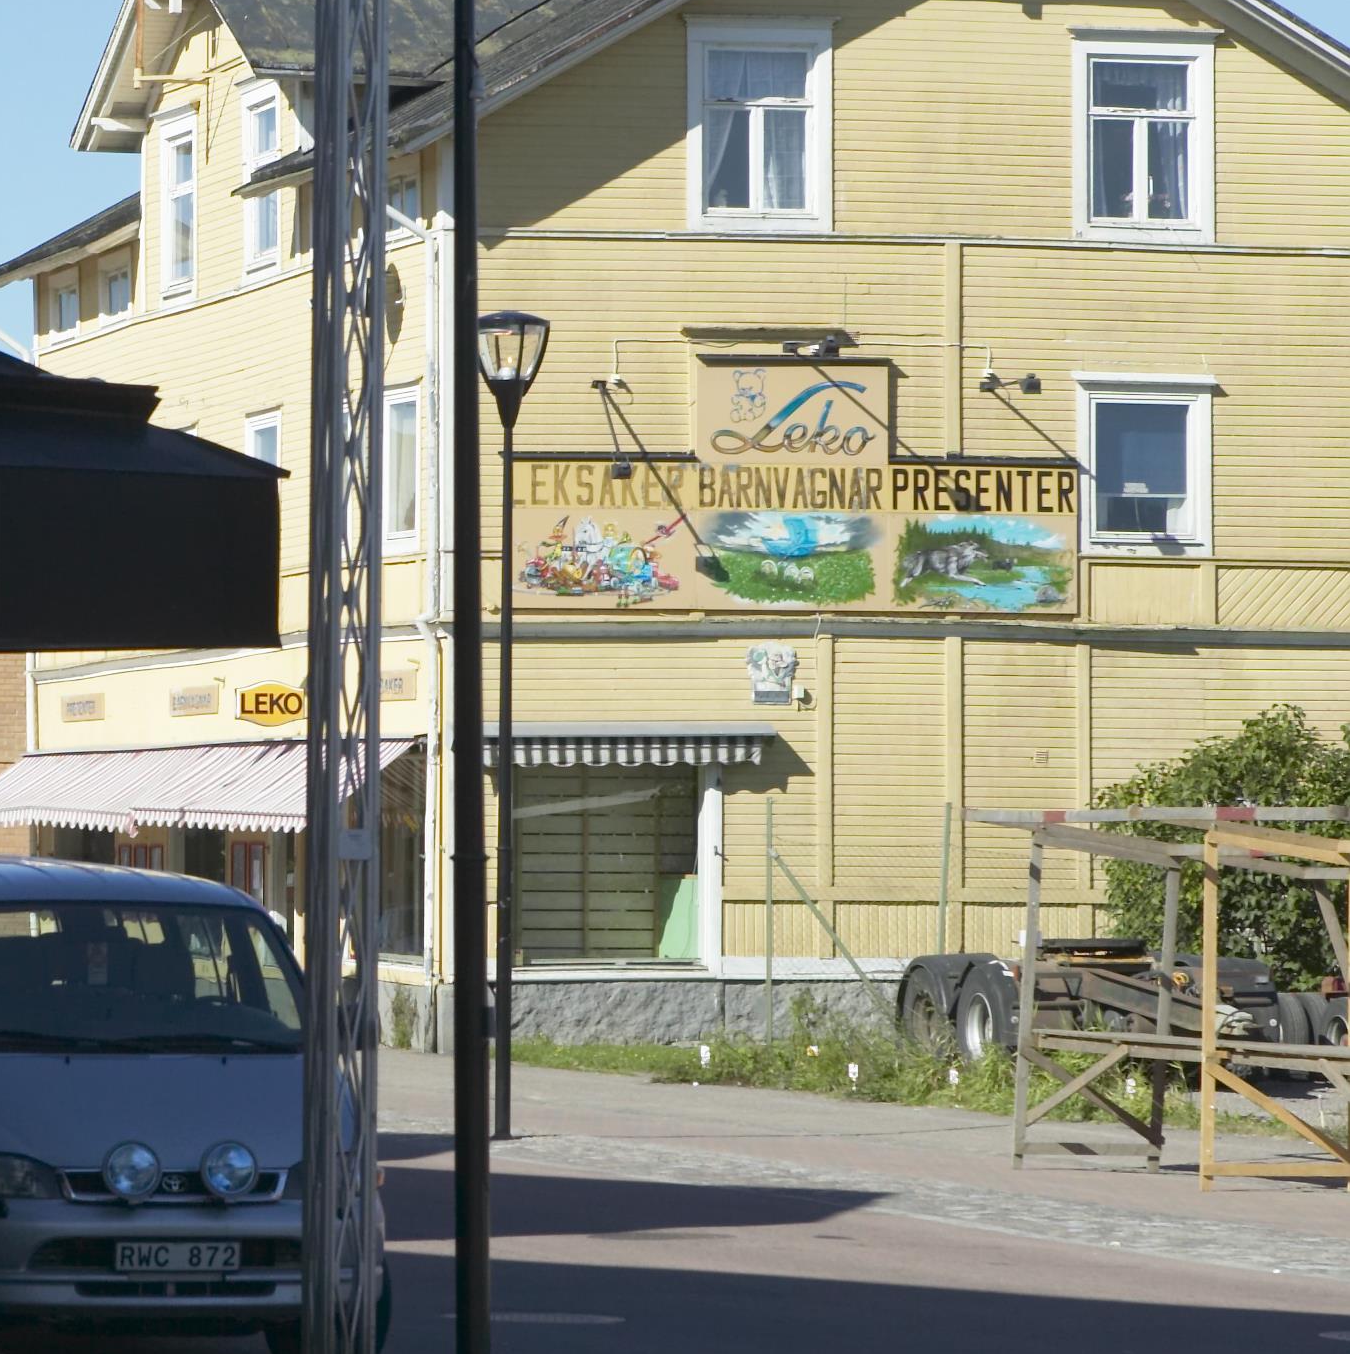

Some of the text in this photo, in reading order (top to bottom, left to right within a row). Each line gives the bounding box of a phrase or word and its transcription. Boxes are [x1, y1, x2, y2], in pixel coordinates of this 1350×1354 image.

[710, 381, 876, 455] Leko
[513, 464, 1074, 512] EKSAKER BARNVAGNAR PRESENTER
[240, 692, 303, 715] LEKO
[120, 1246, 236, 1267] RWC 872
